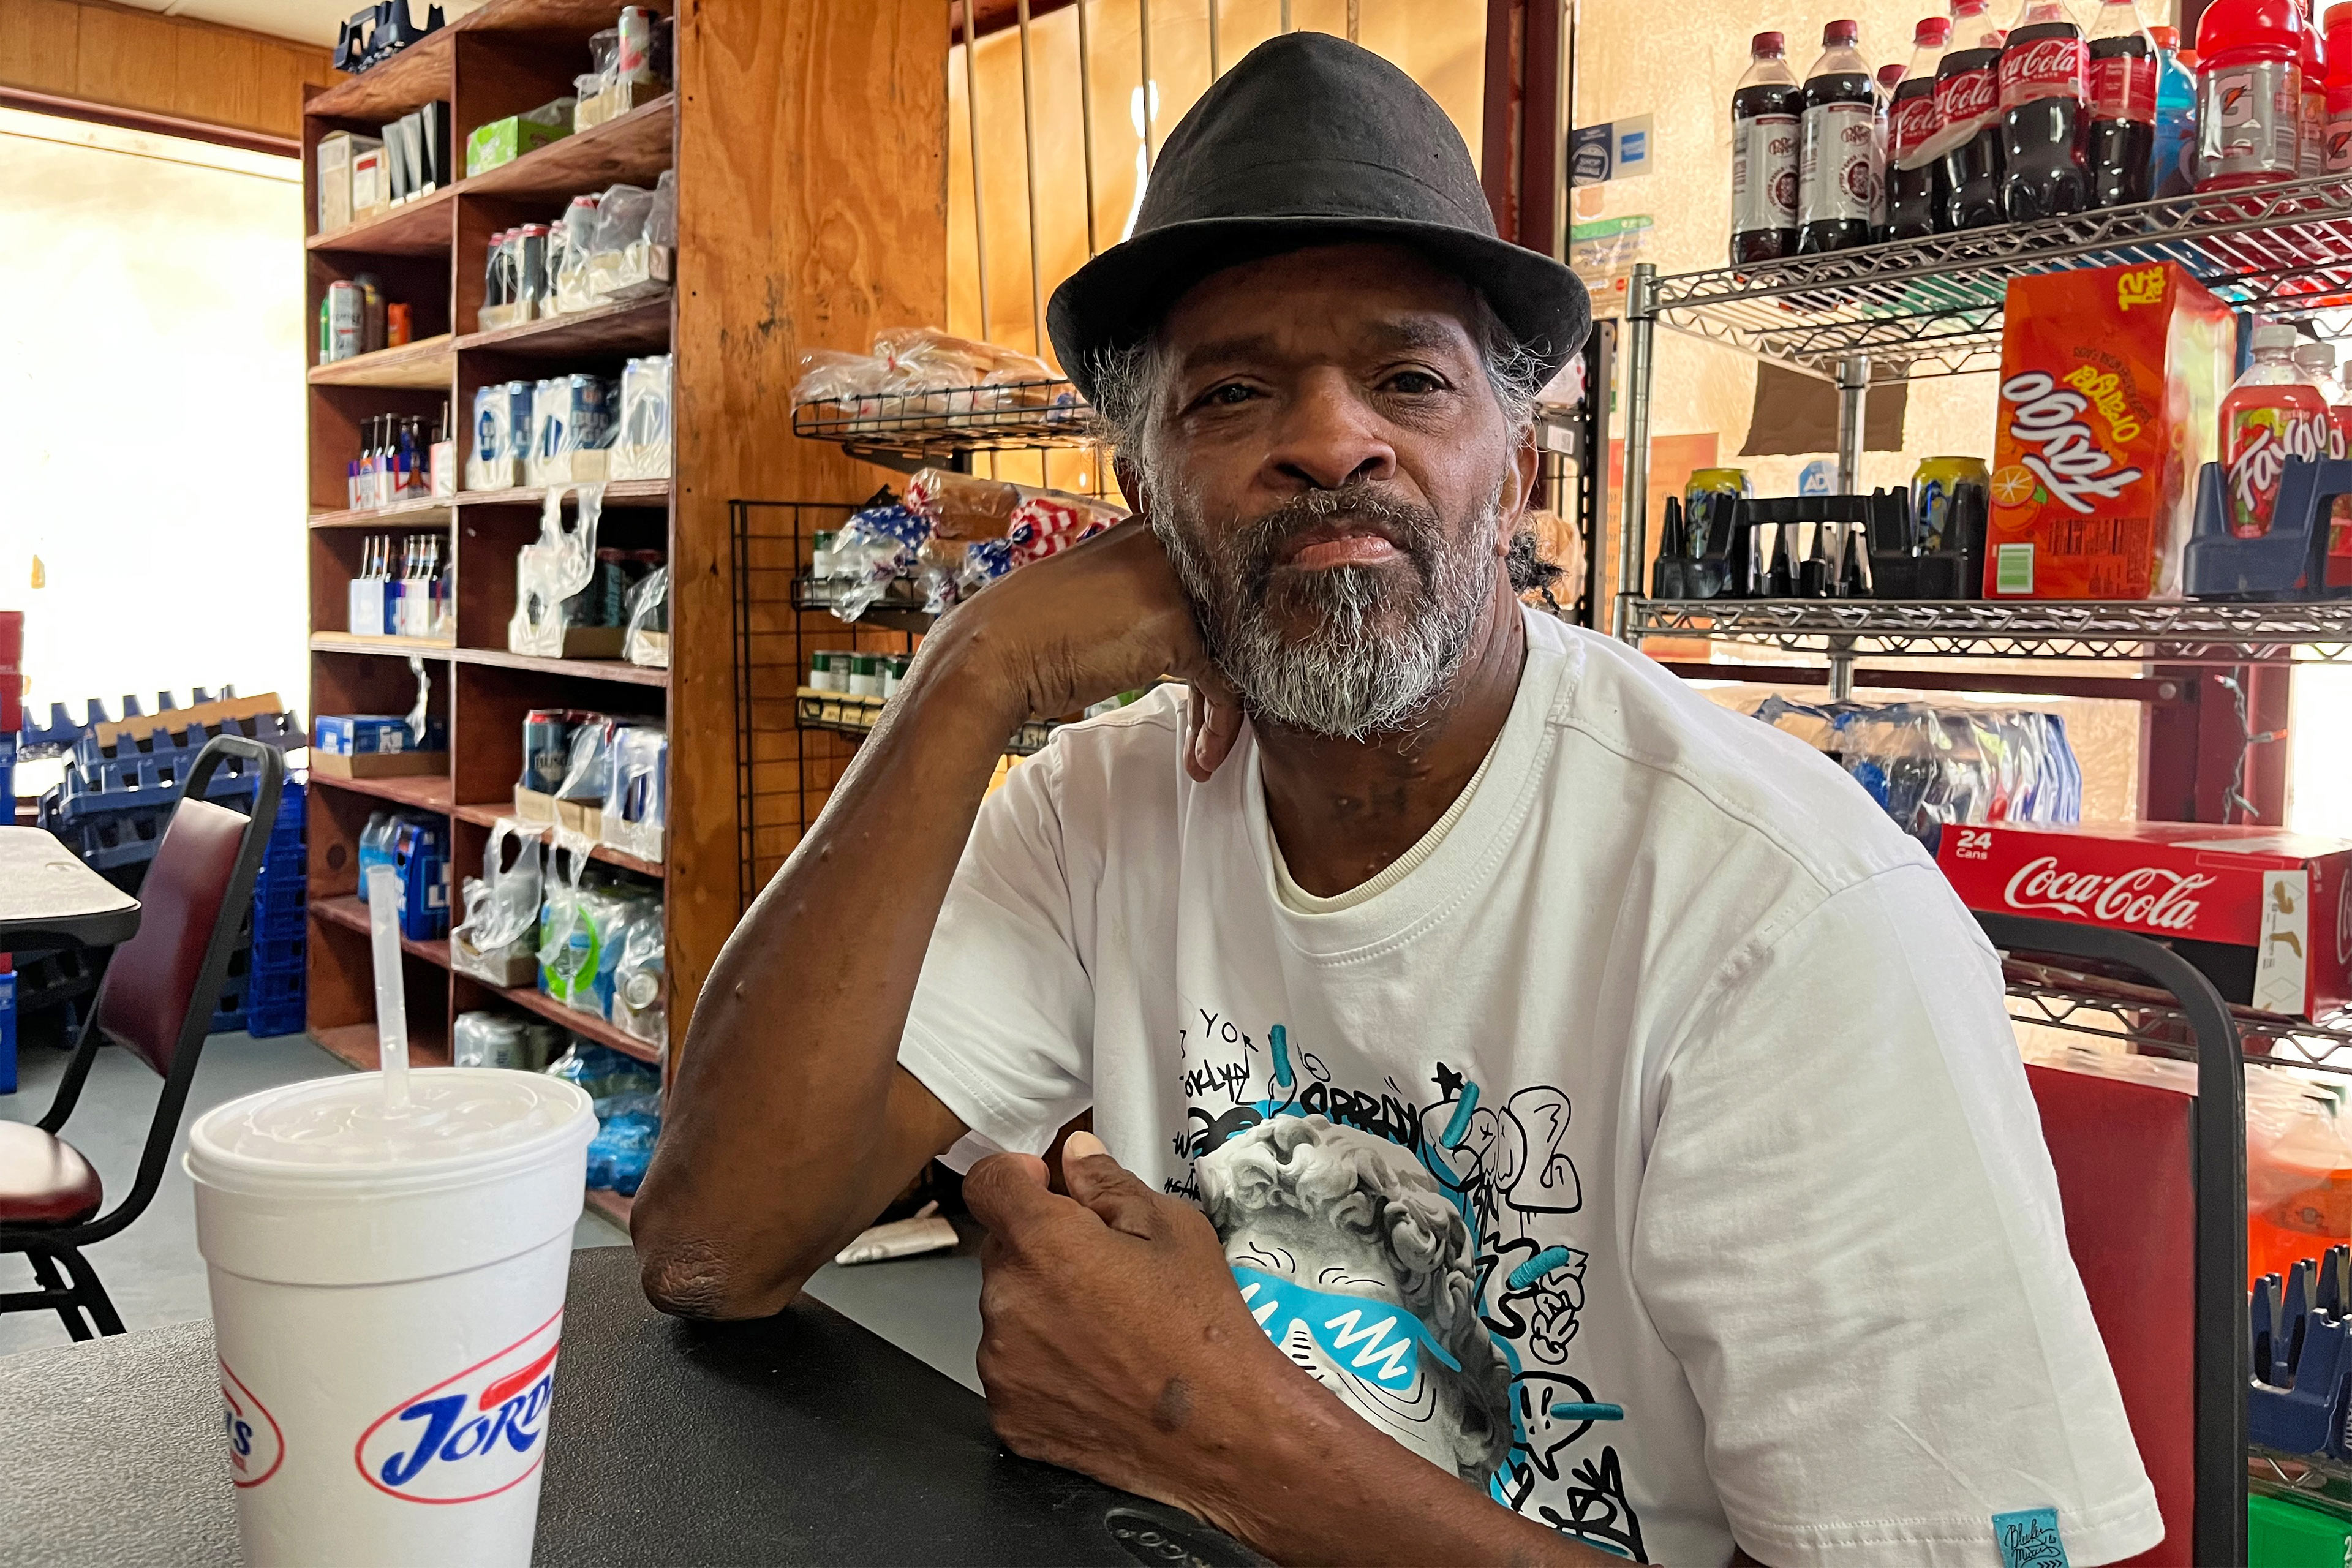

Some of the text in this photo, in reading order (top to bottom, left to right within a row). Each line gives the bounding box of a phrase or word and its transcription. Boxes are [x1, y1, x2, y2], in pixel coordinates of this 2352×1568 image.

[2117, 271, 2144, 311] 12
[2002, 369, 2143, 513] Faygo
[2228, 412, 2326, 511] Faygo
[1803, 472, 1828, 491] AD
[1956, 829, 1992, 850] 24
[1956, 847, 1988, 860] Cans
[2004, 856, 2217, 930] Coca-Cola
[380, 1374, 553, 1487] JORD
